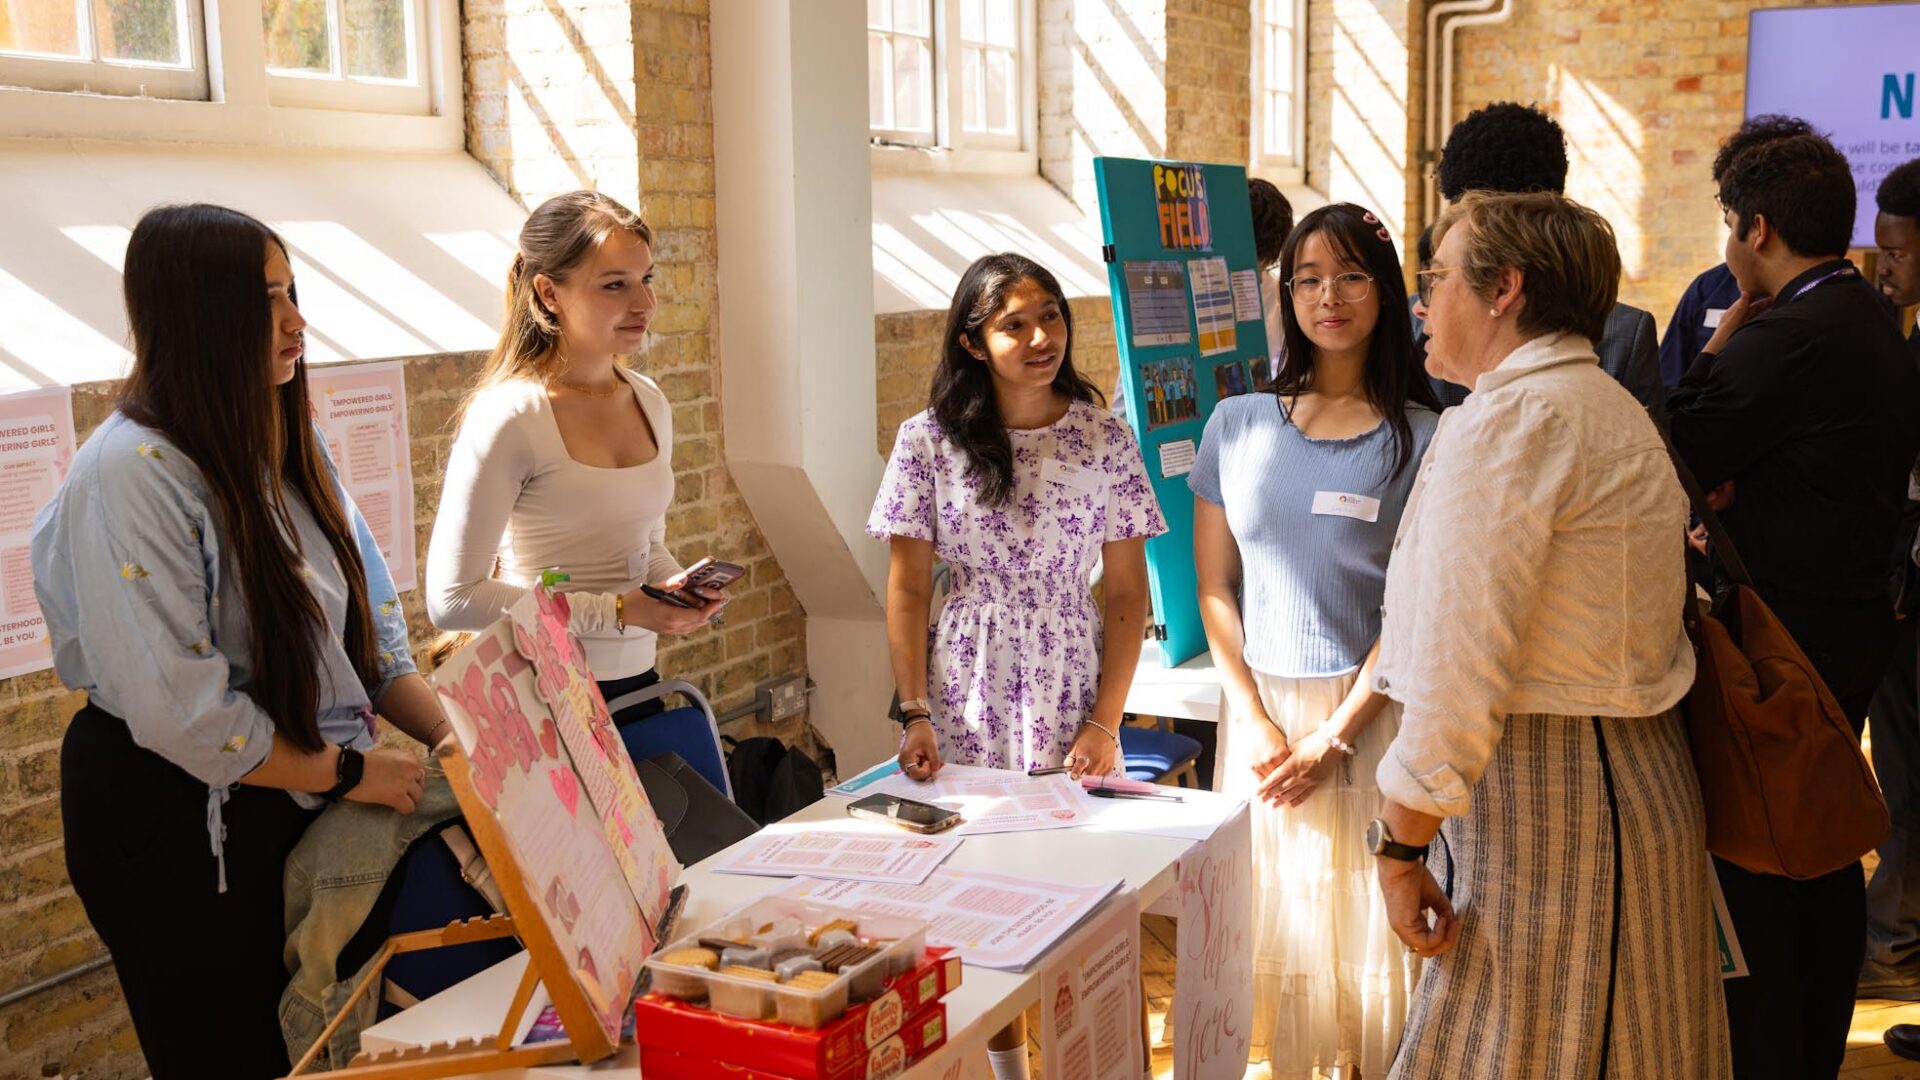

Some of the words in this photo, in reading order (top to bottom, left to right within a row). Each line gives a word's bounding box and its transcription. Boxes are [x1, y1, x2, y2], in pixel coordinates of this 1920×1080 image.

[1848, 141, 1875, 154] will
[1880, 141, 1900, 154] be
[1153, 164, 1204, 200] FOCUS
[1158, 201, 1210, 248] FIELD
[330, 408, 375, 419] EMPOWERING
[30, 424, 56, 435] GIRLS
[4, 636, 15, 645] BE
[16, 631, 37, 642] YOU.
[1186, 851, 1237, 960] Sign
